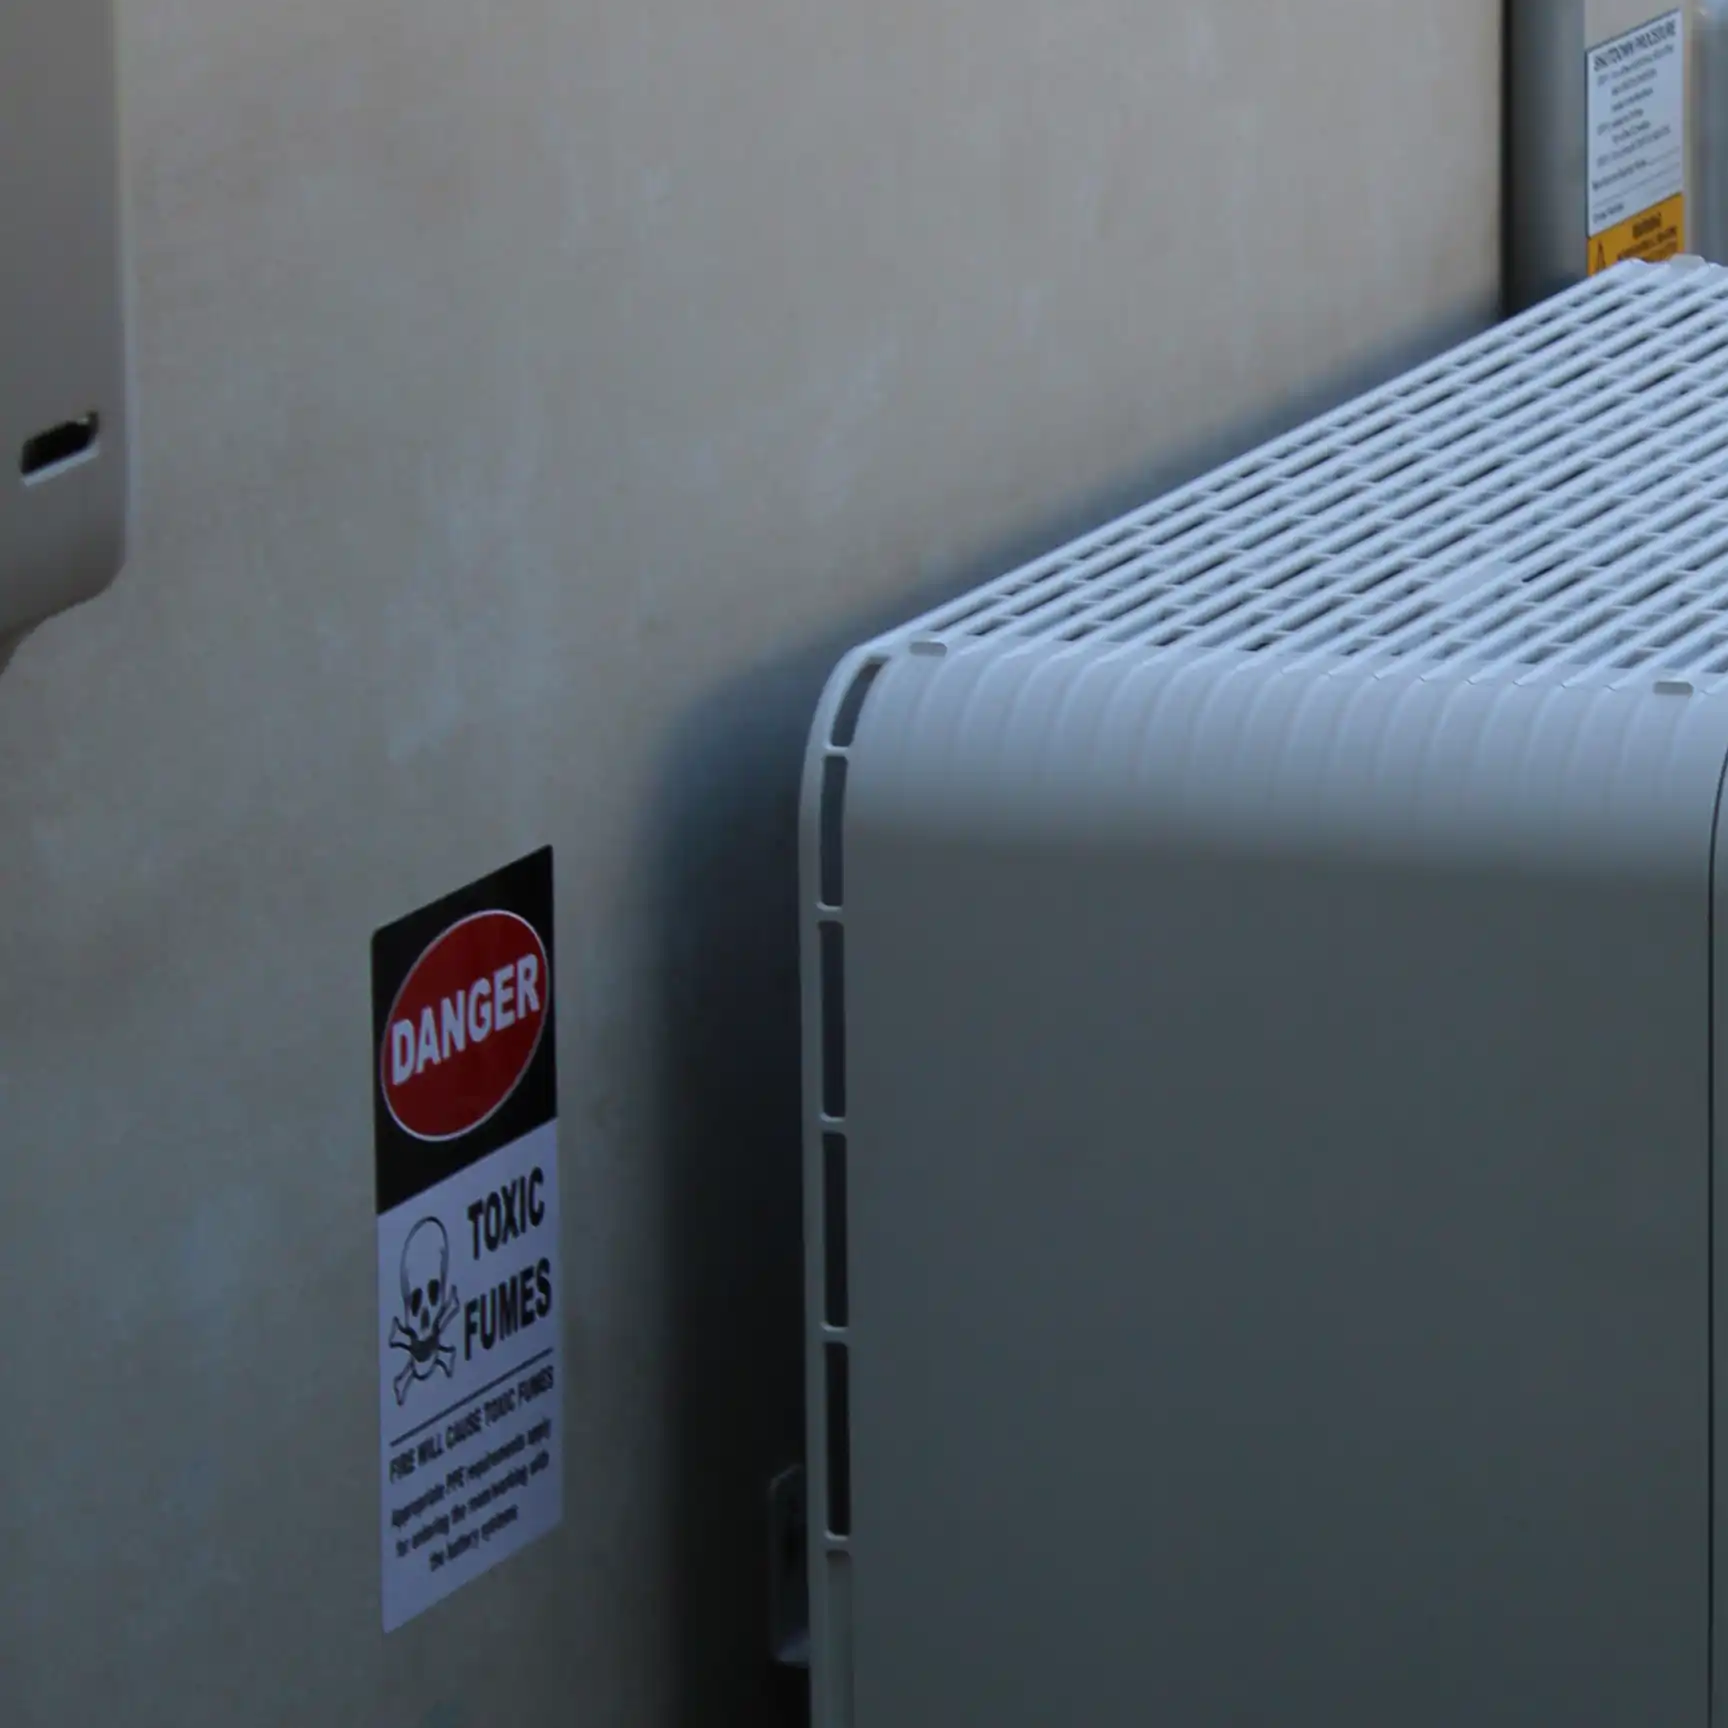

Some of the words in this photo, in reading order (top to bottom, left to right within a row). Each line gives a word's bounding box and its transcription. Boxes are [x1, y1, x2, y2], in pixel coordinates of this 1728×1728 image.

[391, 952, 539, 1086] DANGER
[467, 1165, 545, 1260] TOXIC
[464, 1256, 552, 1361] FUMES
[390, 1447, 415, 1482] FIRE
[418, 1432, 443, 1466] WILL
[446, 1407, 482, 1449] CAUSE
[485, 1387, 516, 1426] TOXIC
[518, 1364, 554, 1402] FUMES
